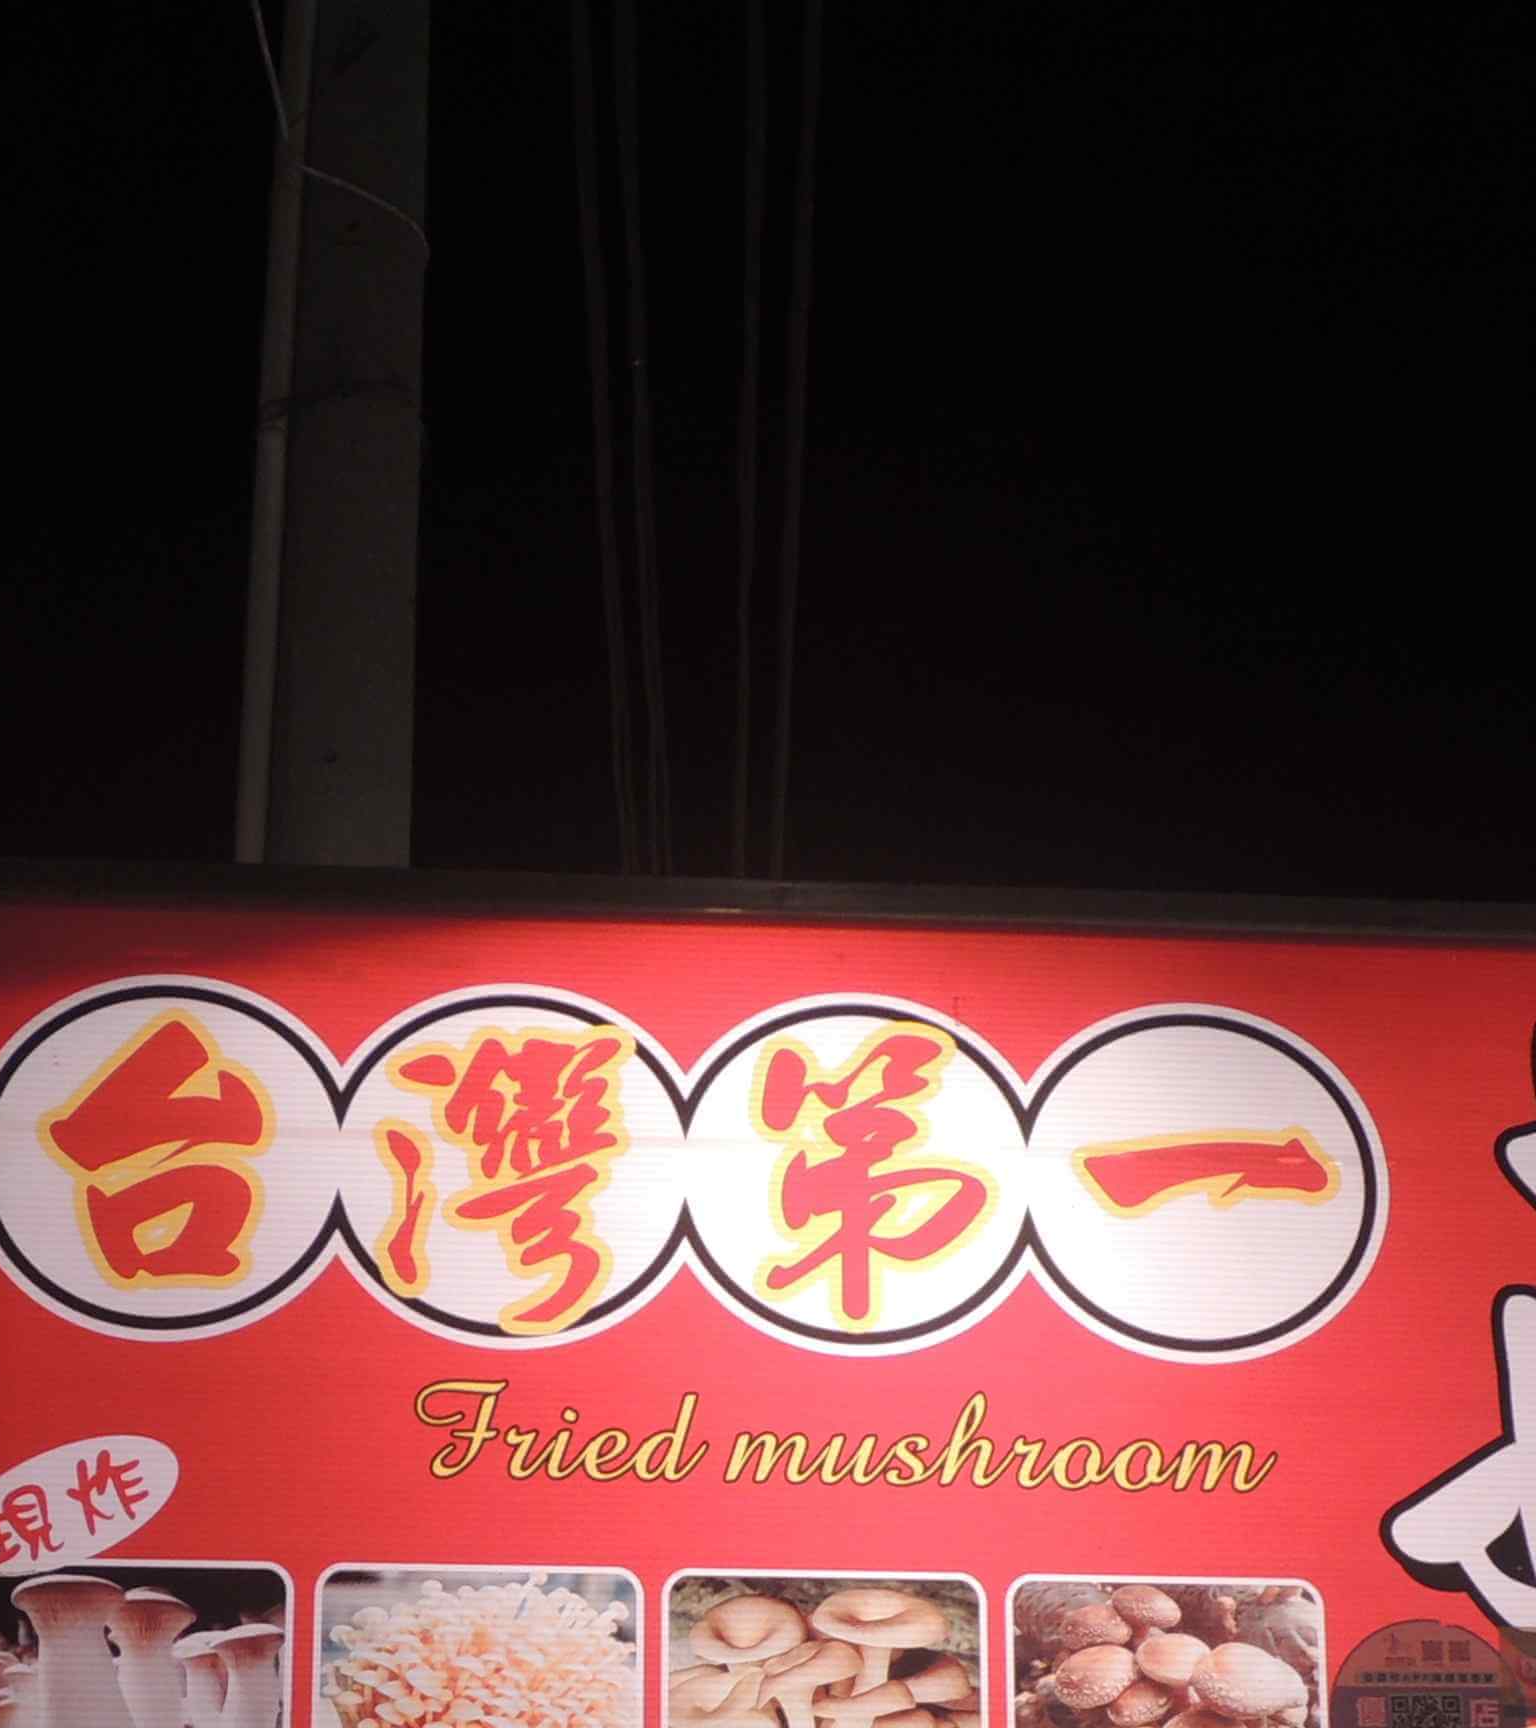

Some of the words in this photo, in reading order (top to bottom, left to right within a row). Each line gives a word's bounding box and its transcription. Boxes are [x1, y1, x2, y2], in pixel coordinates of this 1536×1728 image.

[46, 1012, 1339, 1335] 台灣第一
[414, 1382, 704, 1488] Fried
[726, 1396, 1276, 1496] mushroom
